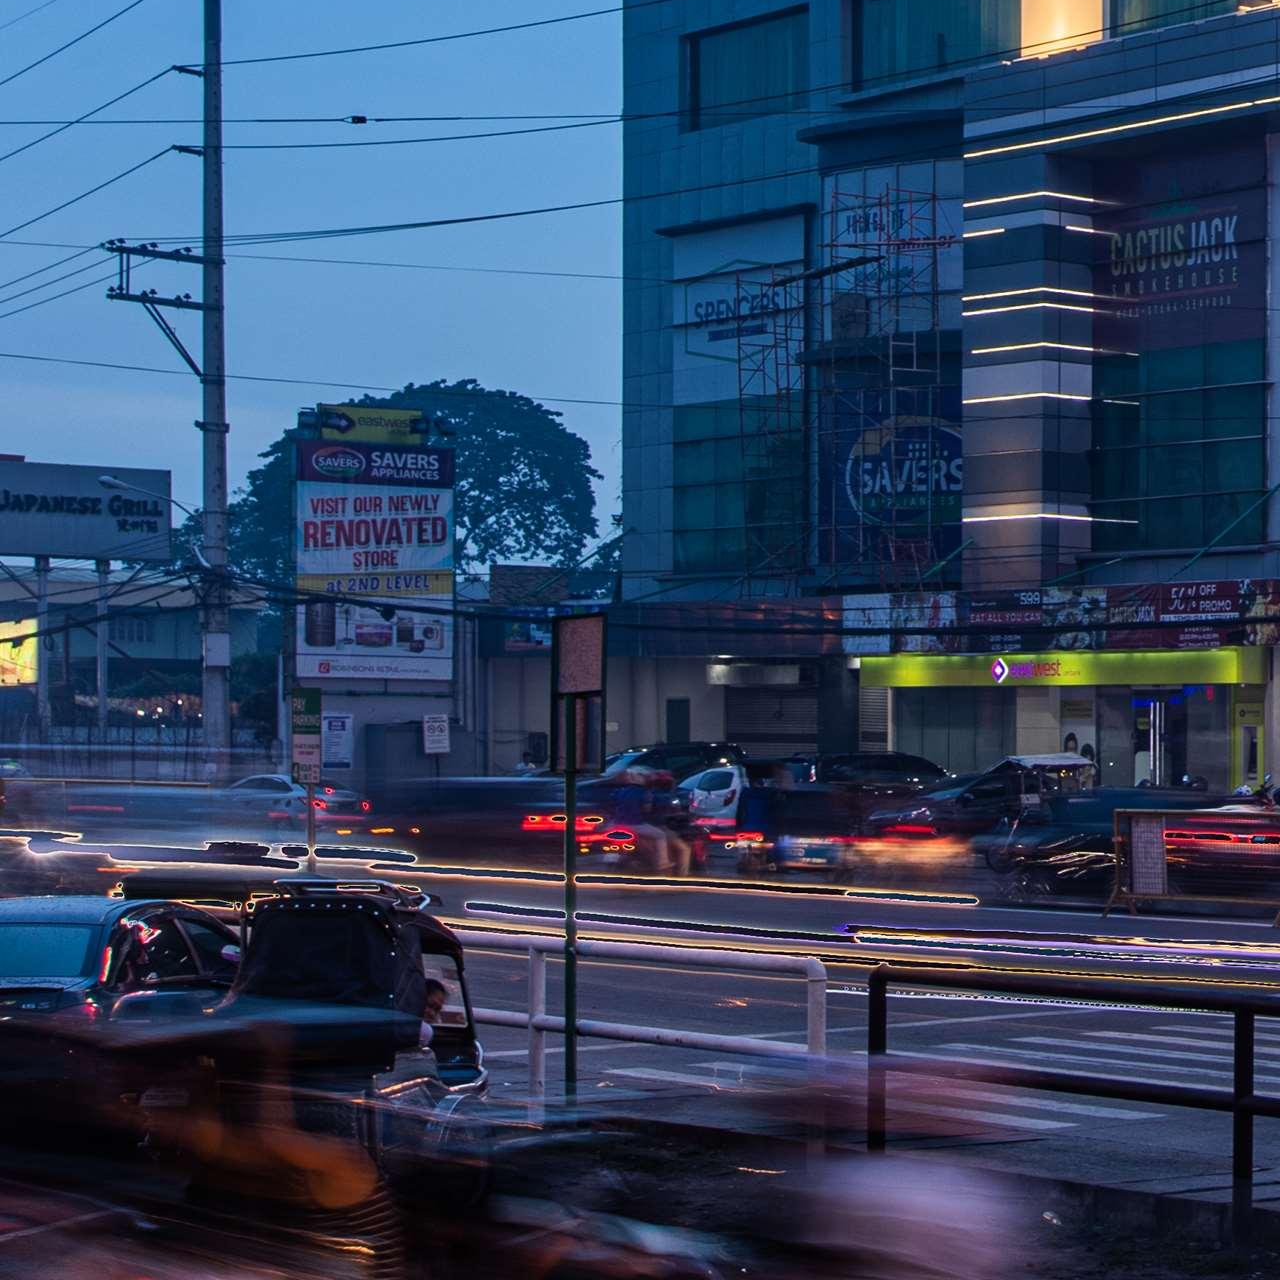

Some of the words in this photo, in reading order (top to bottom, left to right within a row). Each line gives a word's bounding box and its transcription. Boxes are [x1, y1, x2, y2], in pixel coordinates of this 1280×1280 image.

[1110, 223, 1185, 277] CACTUS
[1186, 214, 1239, 267] JACK
[1110, 266, 1240, 298] SMOKEHOUSE
[317, 456, 361, 469] SAVERS
[370, 451, 440, 470] SAVERS
[370, 468, 440, 481] APPLIANCES
[309, 496, 348, 515] VISIT
[353, 495, 383, 513] OUR
[387, 493, 441, 513] NEWLY
[303, 515, 448, 549] RENOVATED
[352, 549, 399, 568] STORE
[326, 580, 342, 593] at
[347, 577, 381, 592] 2ND
[385, 575, 430, 590] LEVEL
[1199, 584, 1217, 596] OFF
[1019, 591, 1041, 605] 599
[1199, 599, 1232, 612] PROMO
